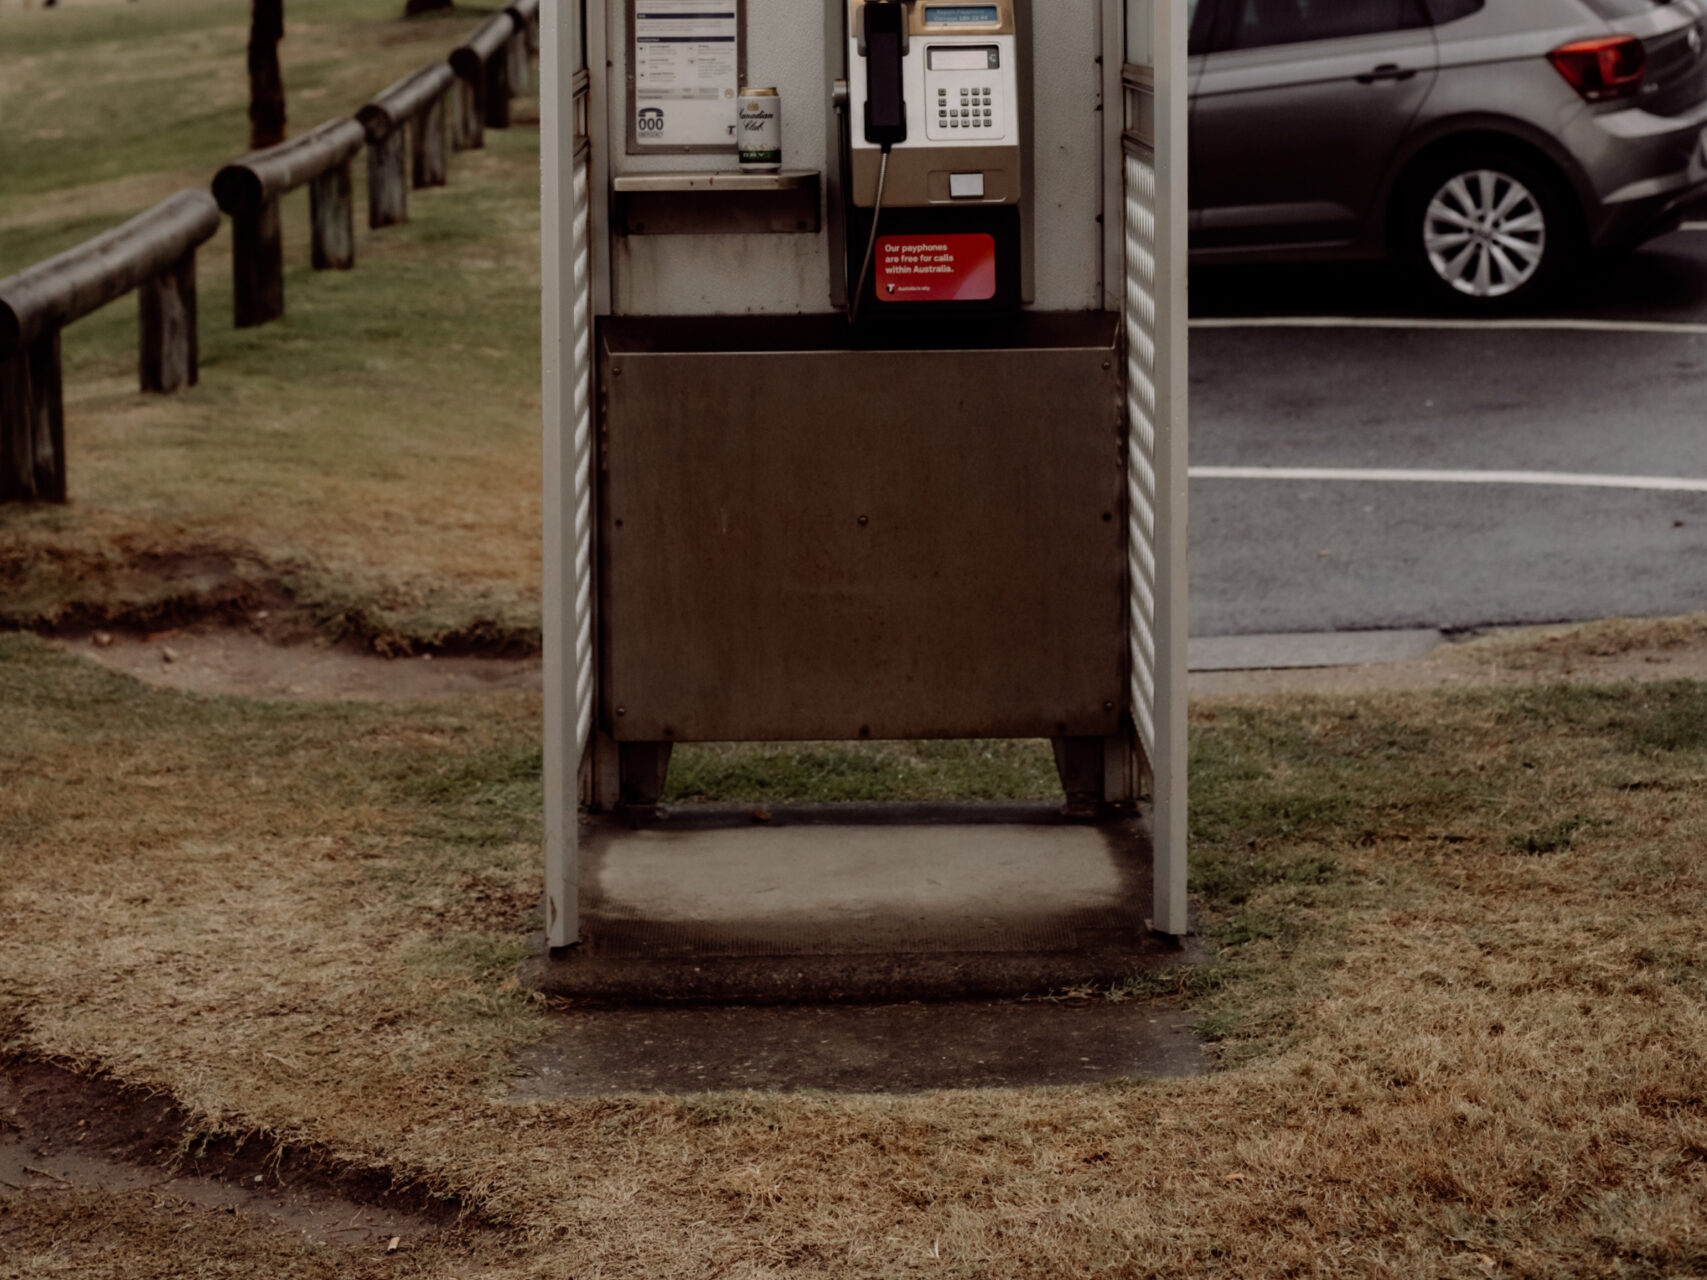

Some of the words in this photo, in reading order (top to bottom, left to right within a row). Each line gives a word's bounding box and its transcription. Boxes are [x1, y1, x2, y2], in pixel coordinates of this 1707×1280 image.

[739, 108, 774, 119] Canadian
[638, 118, 664, 131] 000
[744, 120, 765, 131] Club
[885, 244, 899, 252] Our
[902, 243, 948, 253] payphones
[920, 254, 932, 262] for
[933, 253, 954, 262] calls
[885, 265, 912, 274] within
[913, 264, 954, 273] Australia.
